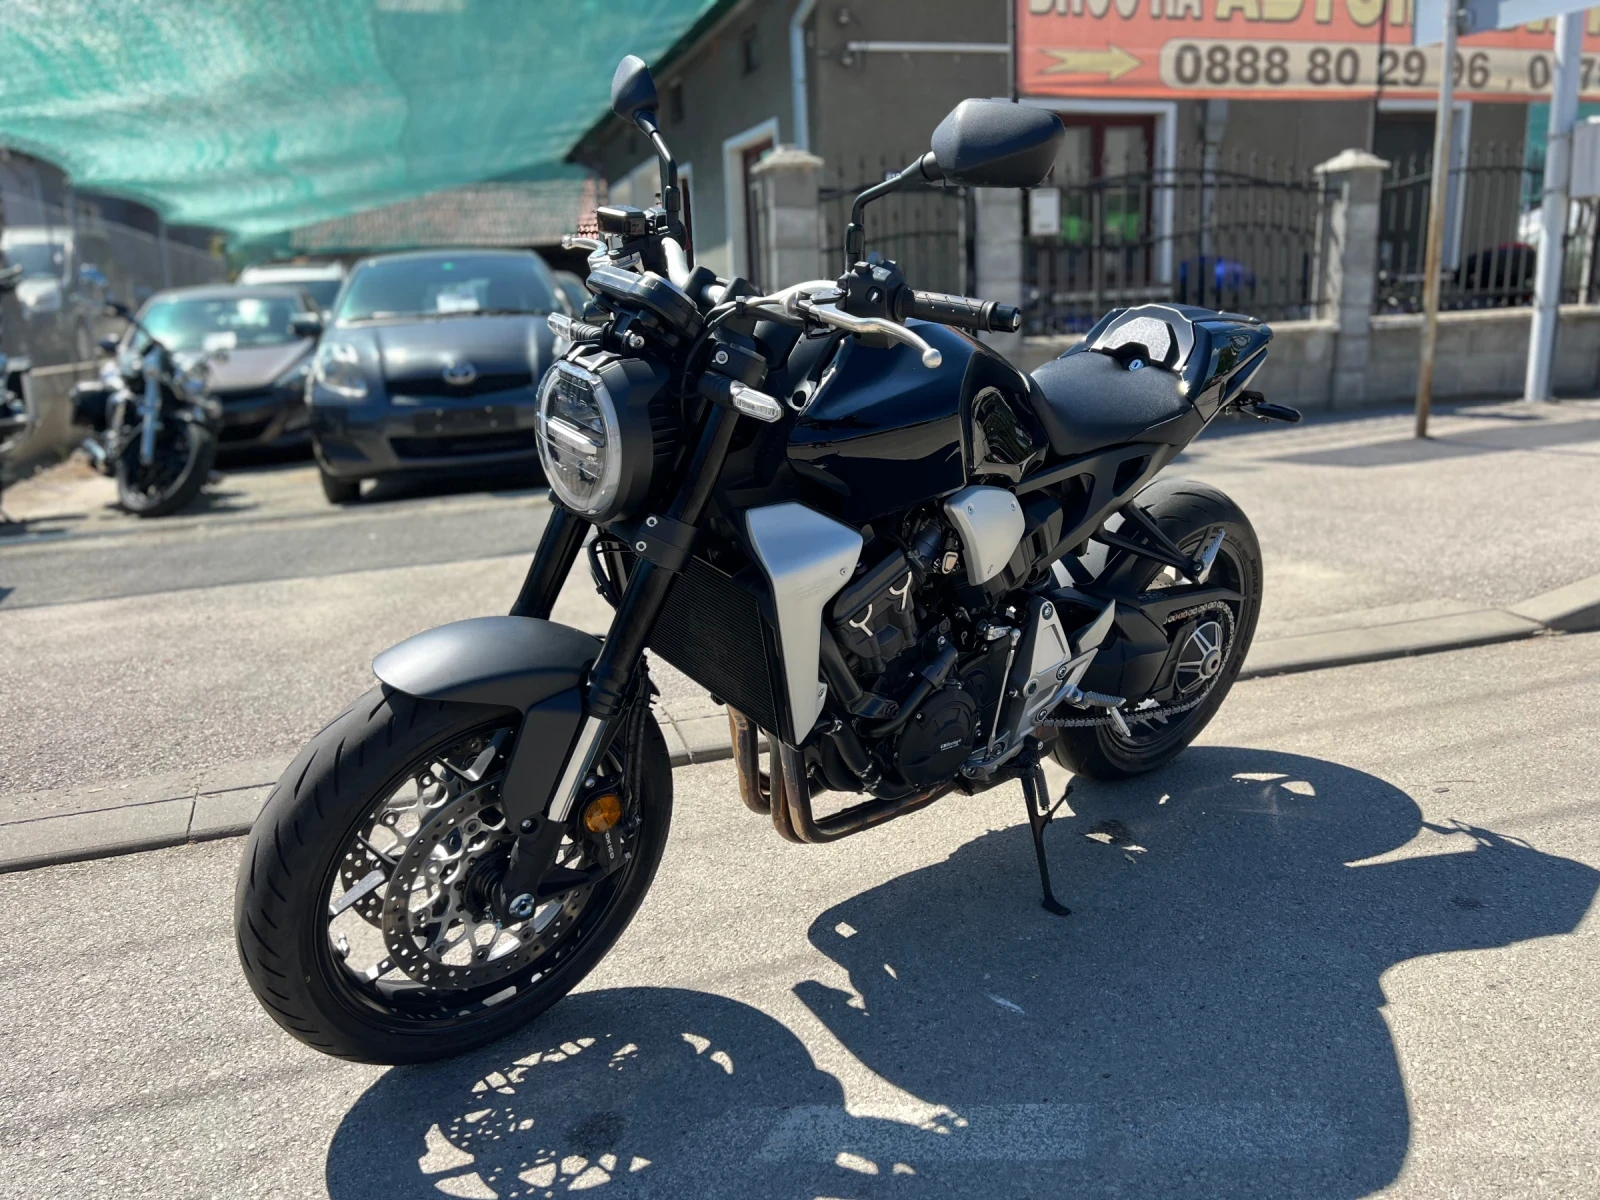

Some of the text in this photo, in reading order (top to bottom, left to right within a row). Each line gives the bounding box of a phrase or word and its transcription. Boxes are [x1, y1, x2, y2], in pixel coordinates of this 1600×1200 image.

[1175, 44, 1289, 86] 0888
[1306, 47, 1370, 86] 80
[1379, 50, 1427, 87] 29
[605, 830, 615, 859] OKICO
